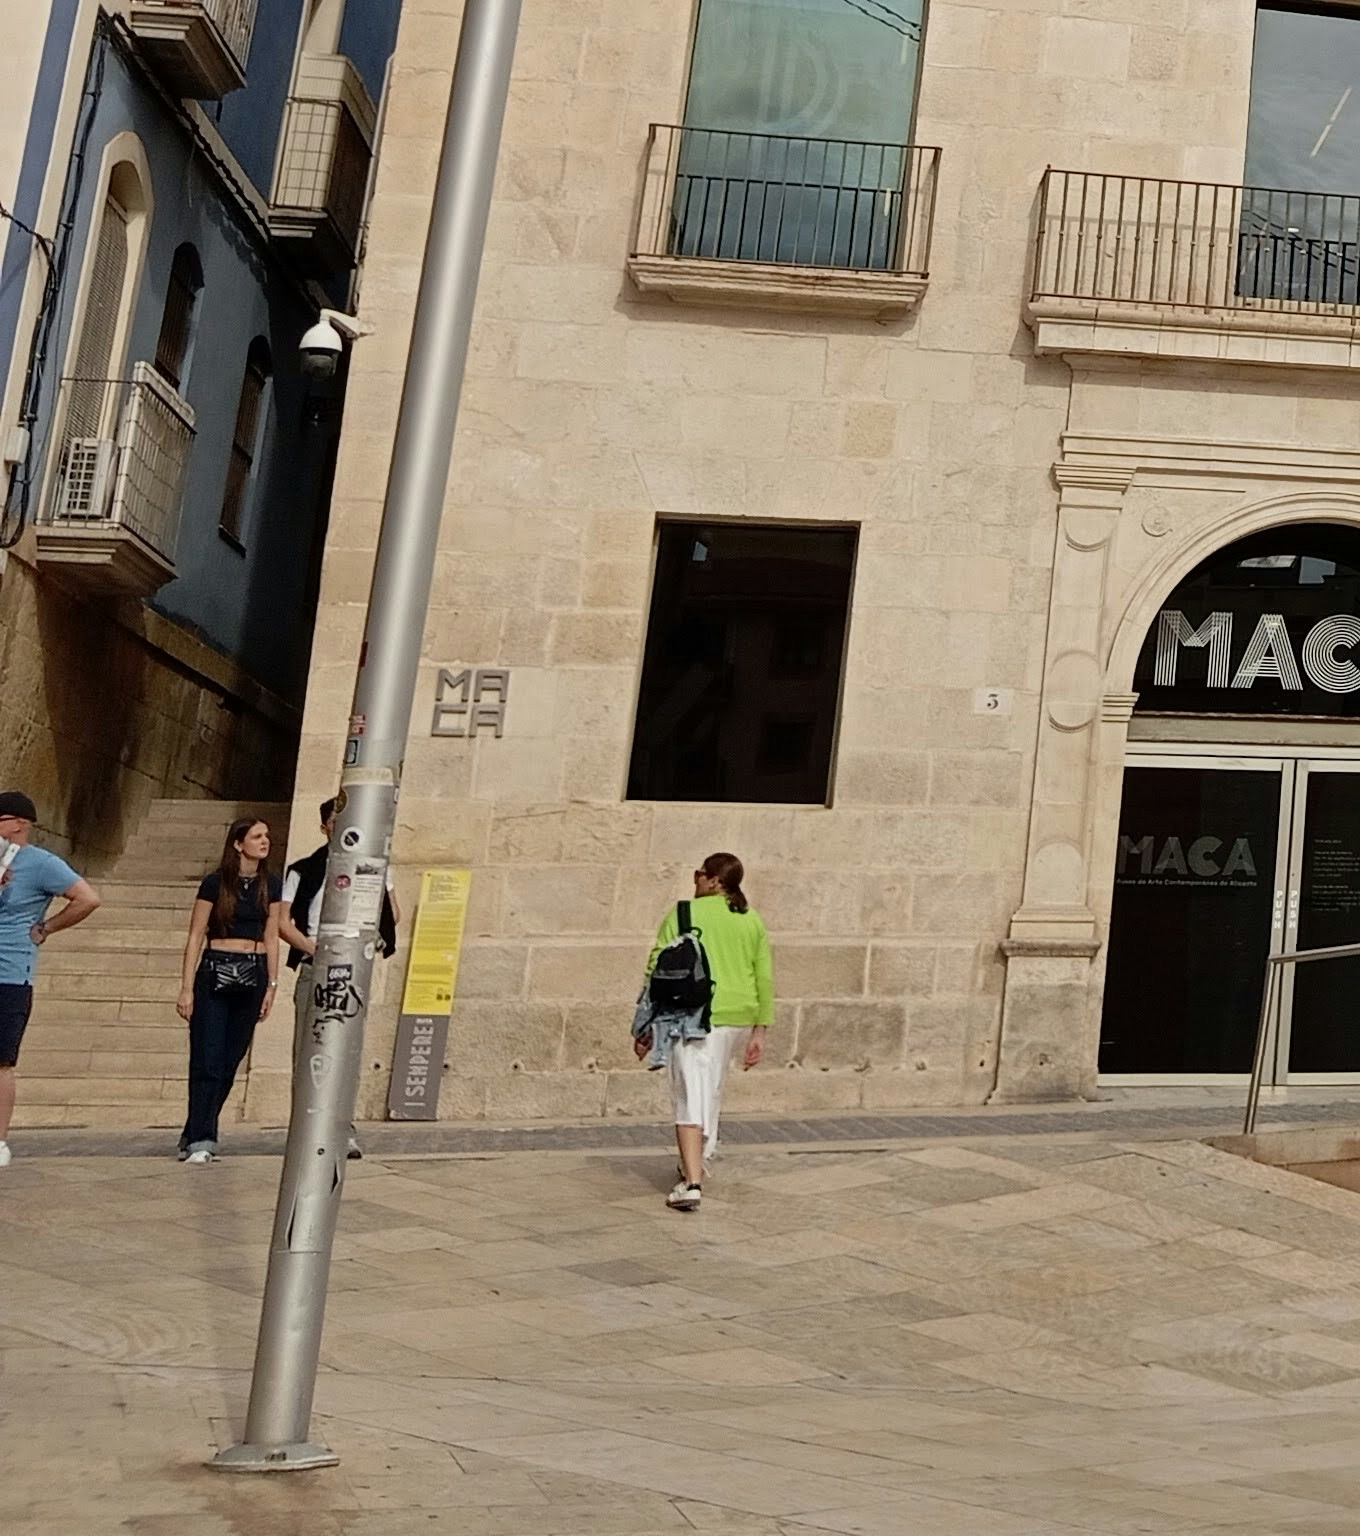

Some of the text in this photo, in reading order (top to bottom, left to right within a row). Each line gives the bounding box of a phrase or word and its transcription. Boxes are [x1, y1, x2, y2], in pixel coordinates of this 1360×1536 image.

[435, 668, 510, 704] MA
[431, 703, 506, 740] CA
[1117, 835, 1258, 877] MACA
[1274, 889, 1283, 929] PUSH
[1289, 889, 1298, 929] PUSH
